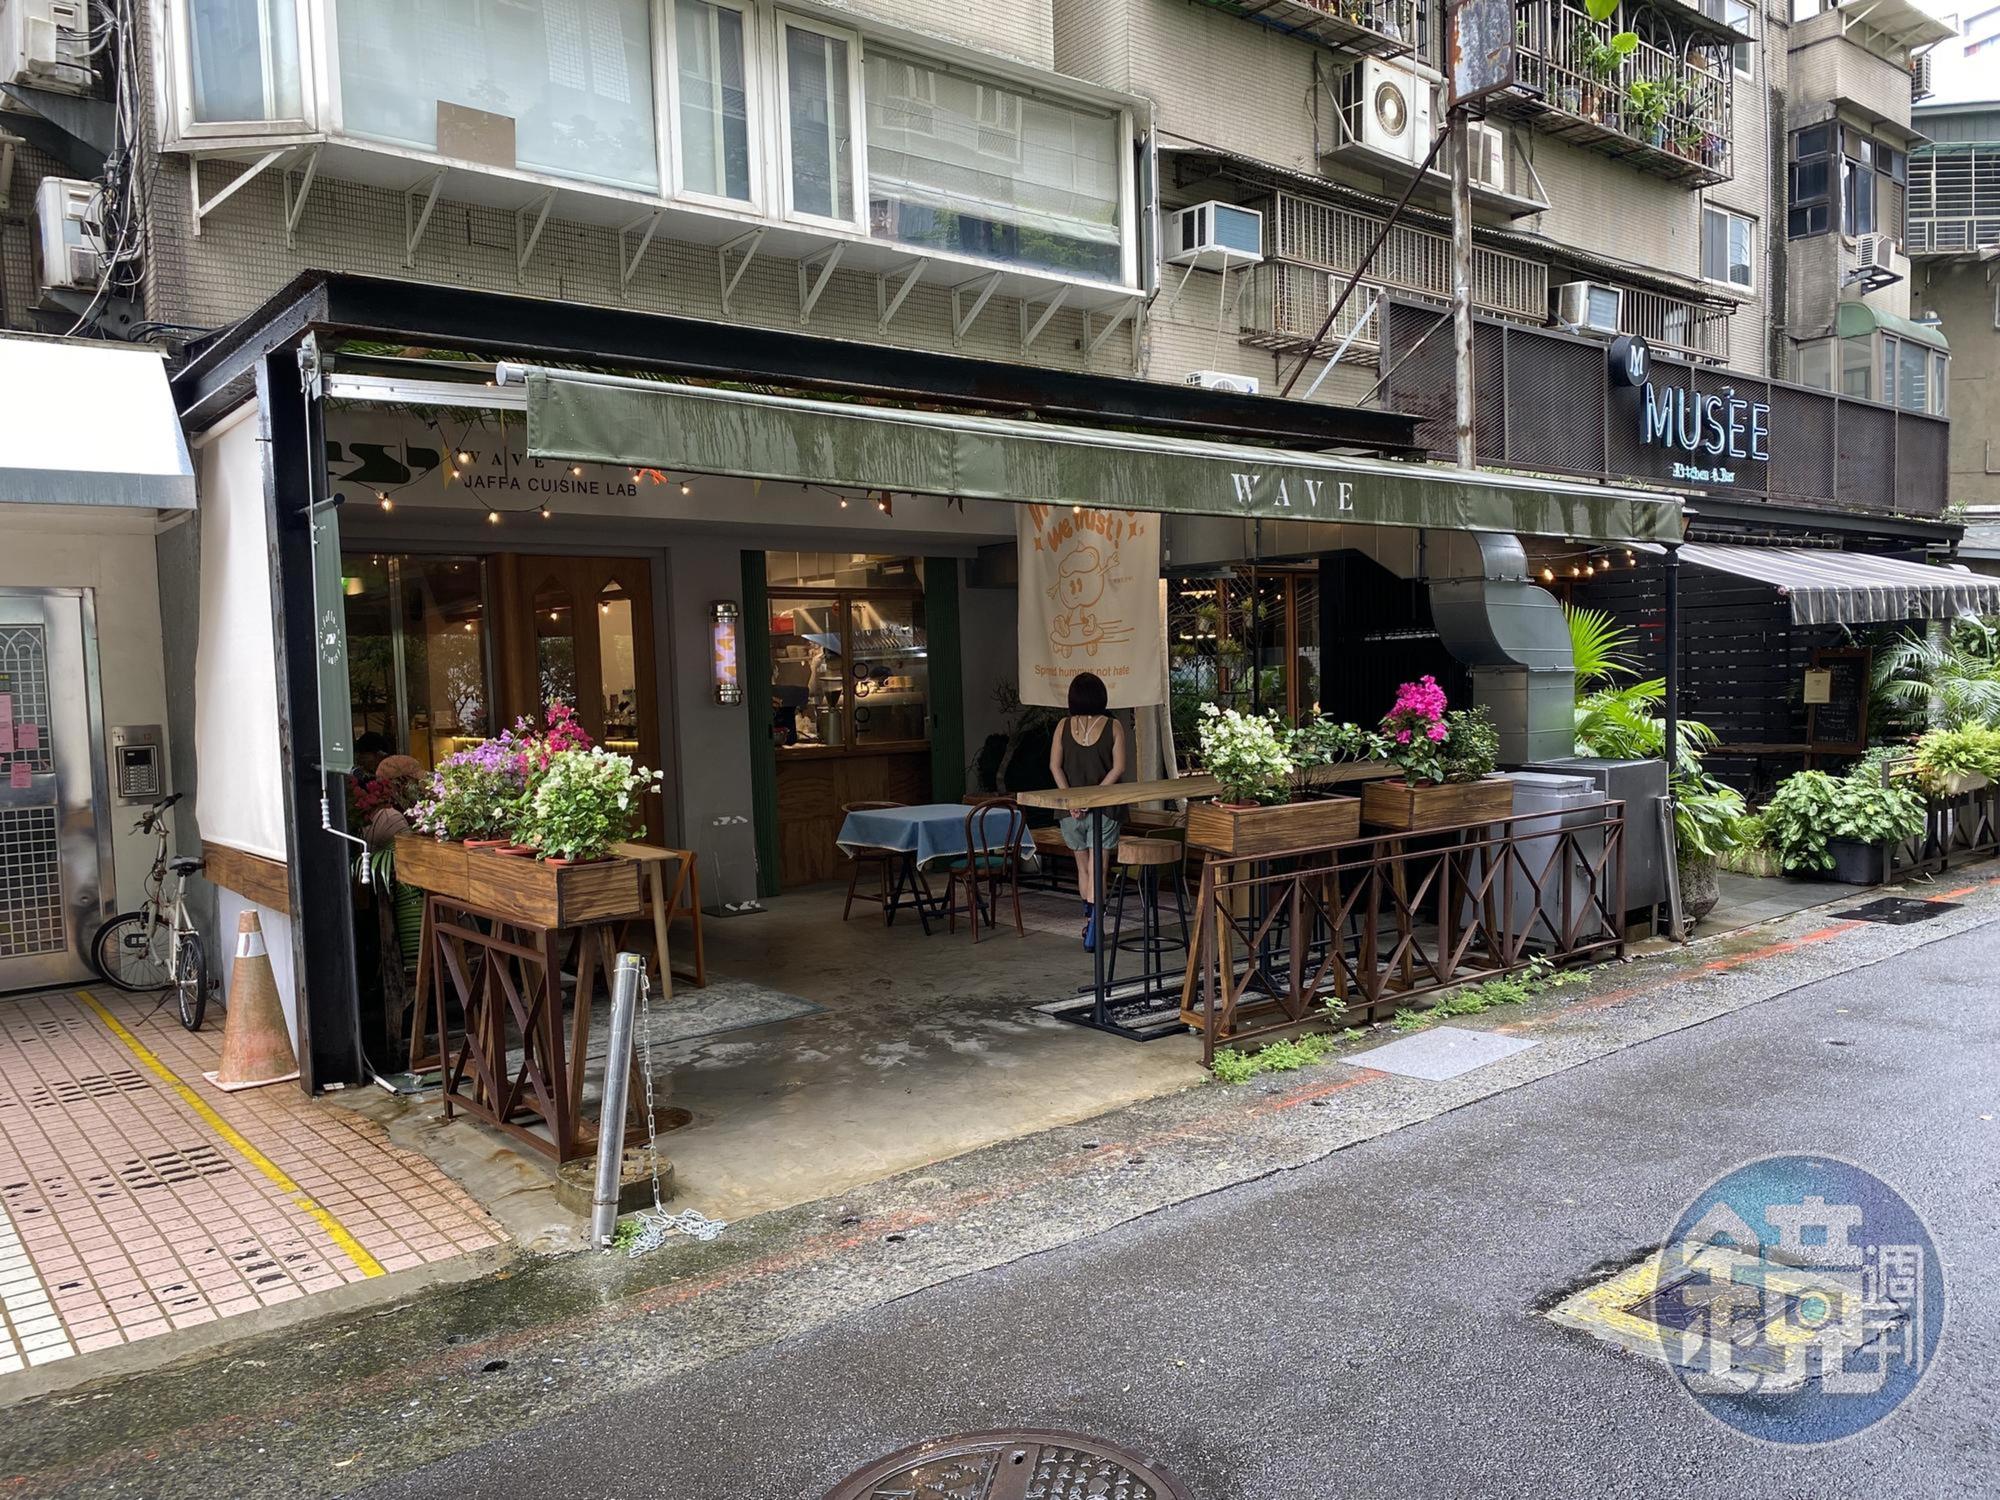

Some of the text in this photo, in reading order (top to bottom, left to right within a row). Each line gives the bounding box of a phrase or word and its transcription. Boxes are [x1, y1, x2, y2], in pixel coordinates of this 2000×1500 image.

[1630, 345, 1645, 377] M
[464, 475, 637, 497] JAFFA CUISINE LAB
[1231, 473, 1353, 510] WAVE
[1047, 518, 1073, 552] we
[1034, 664, 1057, 677] Sprd
[1058, 666, 1094, 677] hum
[1096, 666, 1111, 676] not
